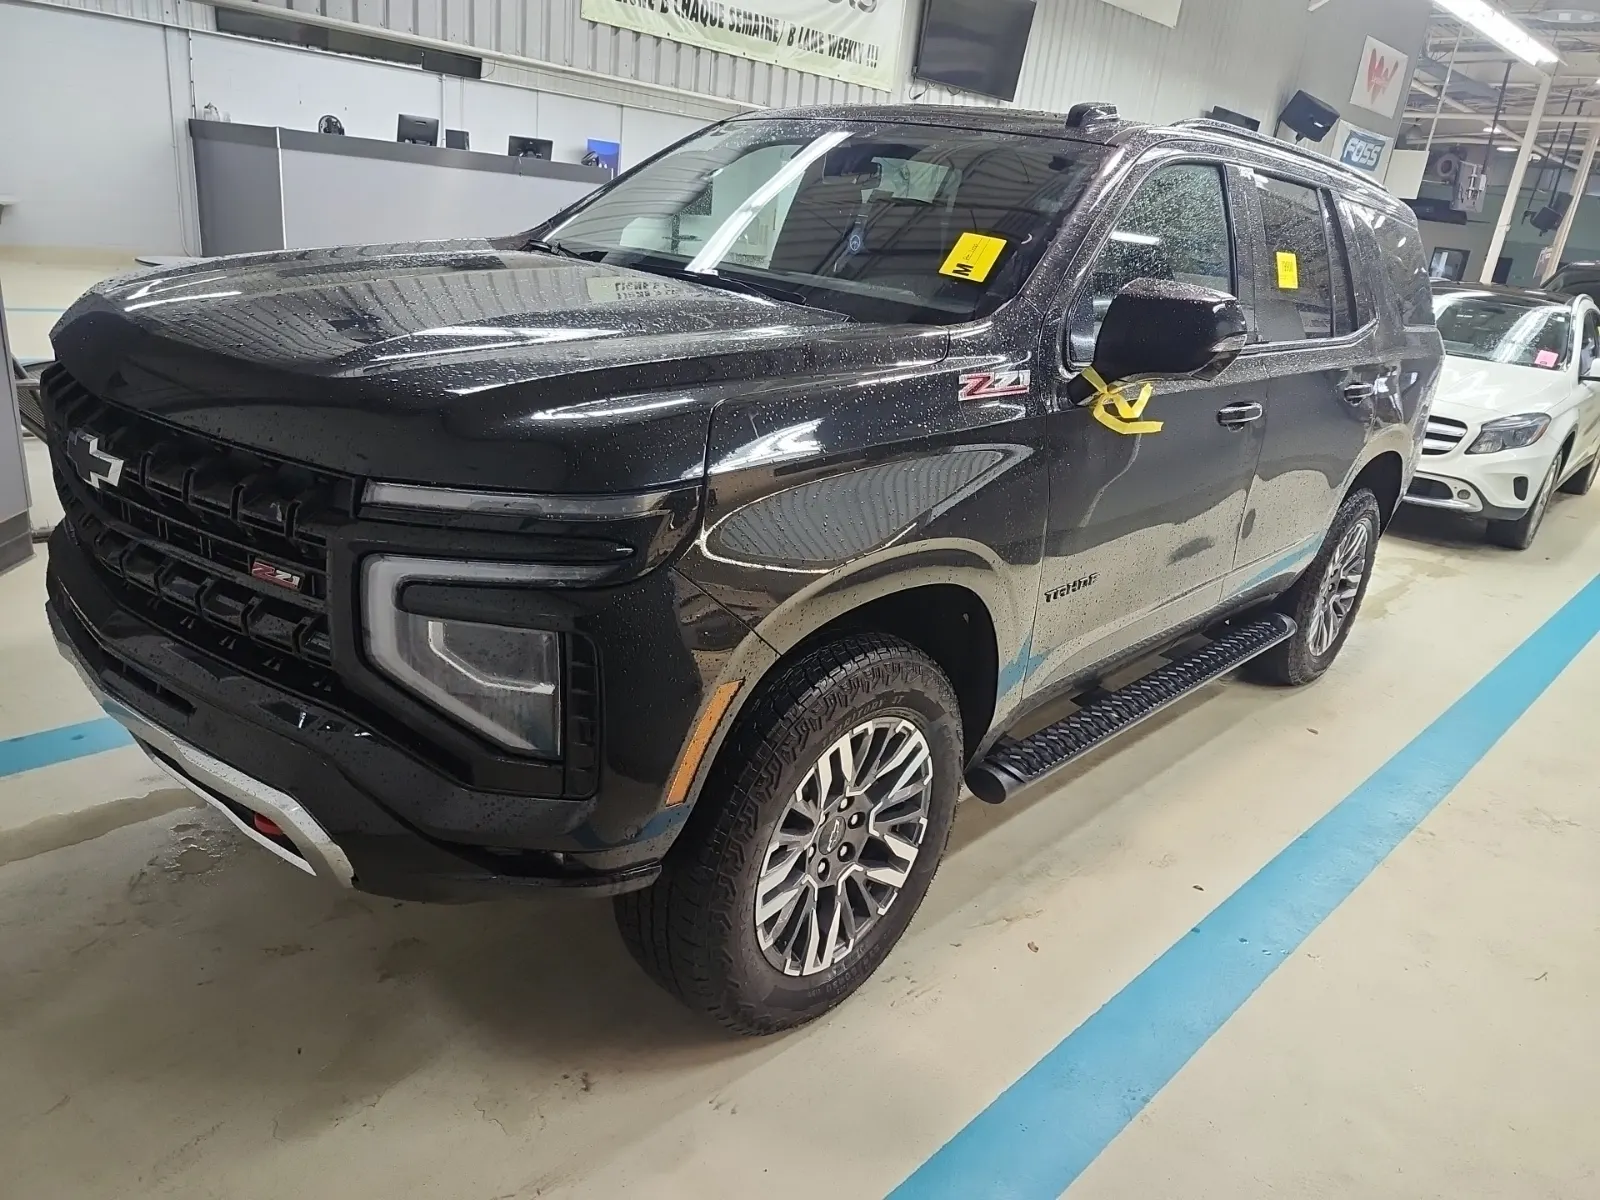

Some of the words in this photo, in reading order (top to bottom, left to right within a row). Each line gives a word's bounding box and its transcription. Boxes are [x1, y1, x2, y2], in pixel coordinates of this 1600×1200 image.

[673, 0, 725, 29] CHAQUE
[787, 22, 797, 47] B
[798, 26, 825, 55] LANE
[827, 33, 865, 65] WEEKLY
[1343, 137, 1381, 167] FOSS
[952, 262, 975, 277] M
[958, 369, 1031, 402] Z71
[252, 561, 300, 589] Z71
